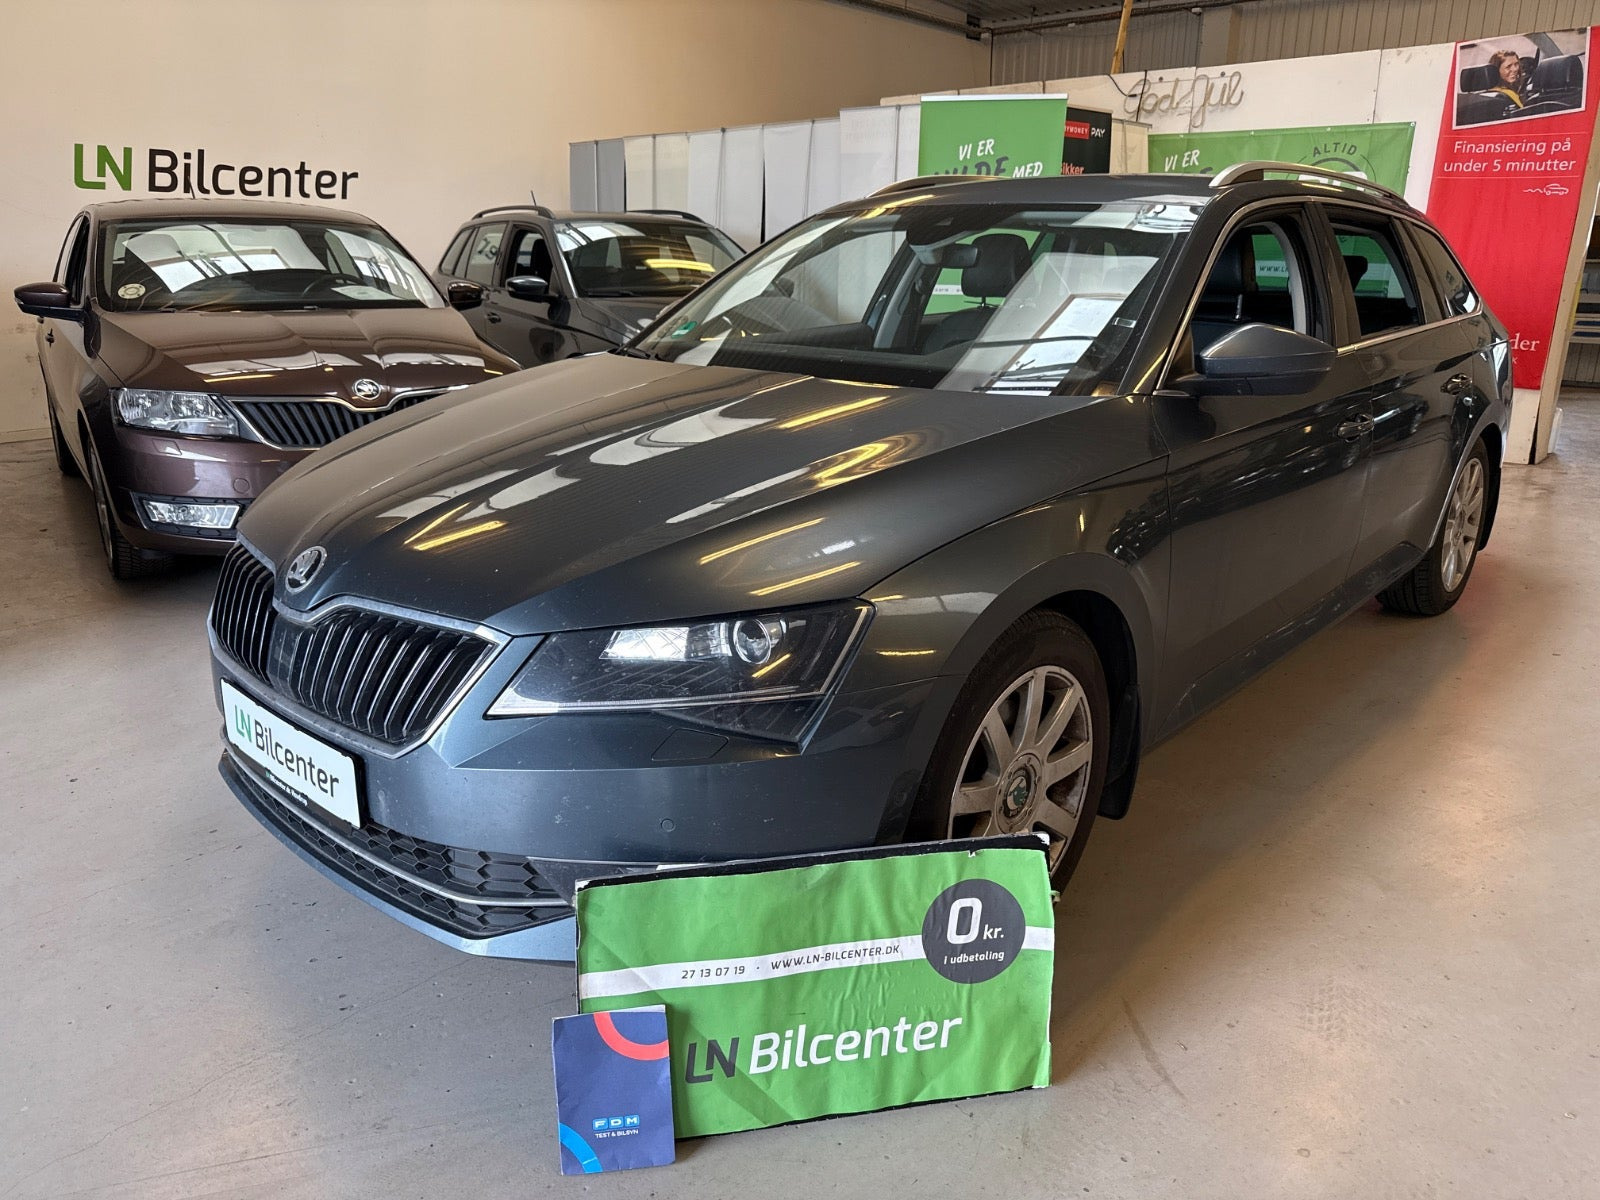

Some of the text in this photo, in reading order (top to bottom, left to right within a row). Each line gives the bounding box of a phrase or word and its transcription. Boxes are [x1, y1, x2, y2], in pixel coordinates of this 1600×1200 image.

[1091, 127, 1105, 138] PAY
[959, 138, 995, 161] VI ER
[1313, 142, 1358, 157] ALTID
[1453, 137, 1571, 155] Finansiering på
[1061, 162, 1084, 175] ikker
[1164, 149, 1200, 172] VI ER
[1444, 158, 1576, 172] under 5 minutter
[74, 143, 359, 200] LN Bilcenter
[1012, 161, 1043, 178] MED
[235, 704, 252, 742] LN
[254, 718, 340, 798] Bilcenter
[946, 897, 1004, 945] 0 kr.
[681, 944, 900, 979] 27 13 07 19 WWW.LN-BILCENTER.DK
[950, 950, 1004, 964] udbetaling
[684, 1016, 963, 1084] LN Bilcenter
[594, 1117, 638, 1128] FDM
[617, 1129, 639, 1137] BILSYN
